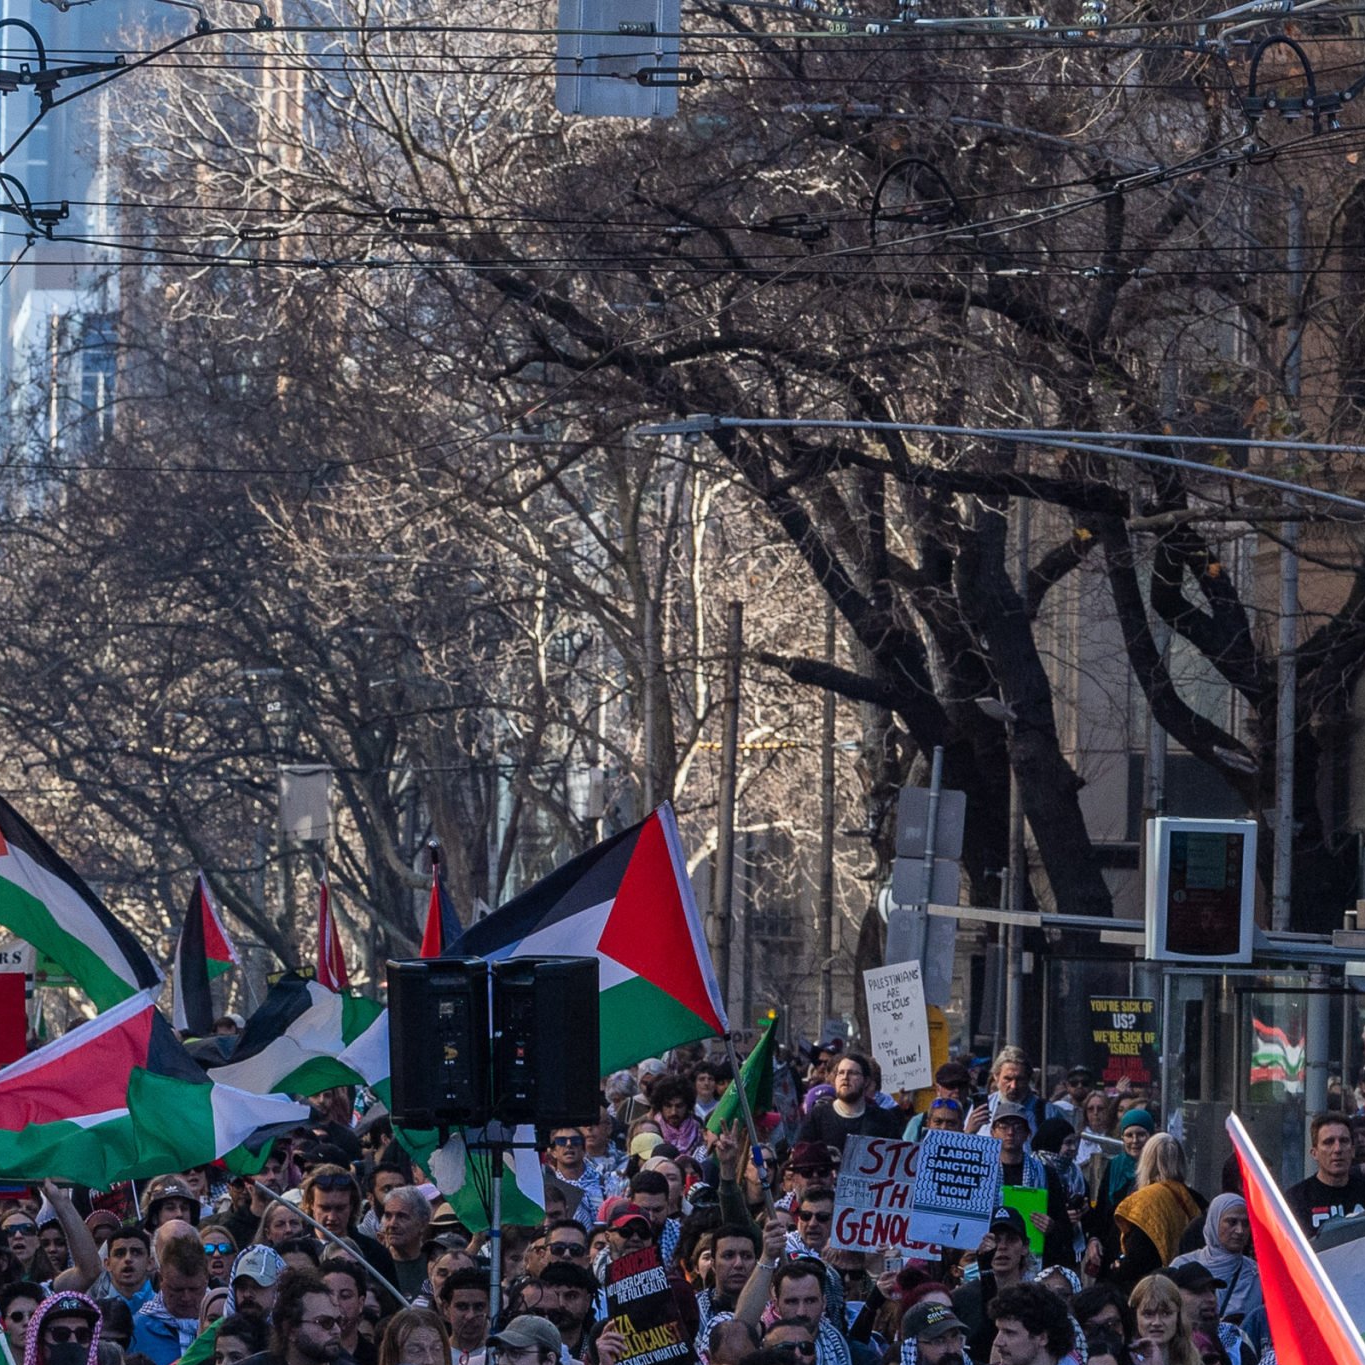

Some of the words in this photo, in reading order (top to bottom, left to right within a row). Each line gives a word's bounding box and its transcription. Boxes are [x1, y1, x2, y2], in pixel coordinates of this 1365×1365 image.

[868, 969, 919, 991] PALESTINIANS
[886, 987, 900, 999] ARE
[1091, 1000, 1119, 1012] YOU'RE
[1121, 1001, 1140, 1012] SICK
[1142, 1001, 1154, 1013] OF
[1113, 1013, 1136, 1029] US?
[1093, 1030, 1121, 1042] WE'RE
[1122, 1031, 1142, 1043] SICK
[1144, 1032, 1155, 1043] OF
[939, 1148, 980, 1162] LABOR
[928, 1159, 989, 1175] SANCTION
[935, 1173, 978, 1186] ISRAEL
[940, 1185, 970, 1197] NOW
[615, 1277, 634, 1296] LONGER
[634, 1266, 666, 1285] CAPTURES
[617, 1291, 629, 1305] THE
[628, 1286, 643, 1302] FULL
[653, 1347, 671, 1363] WHAT
